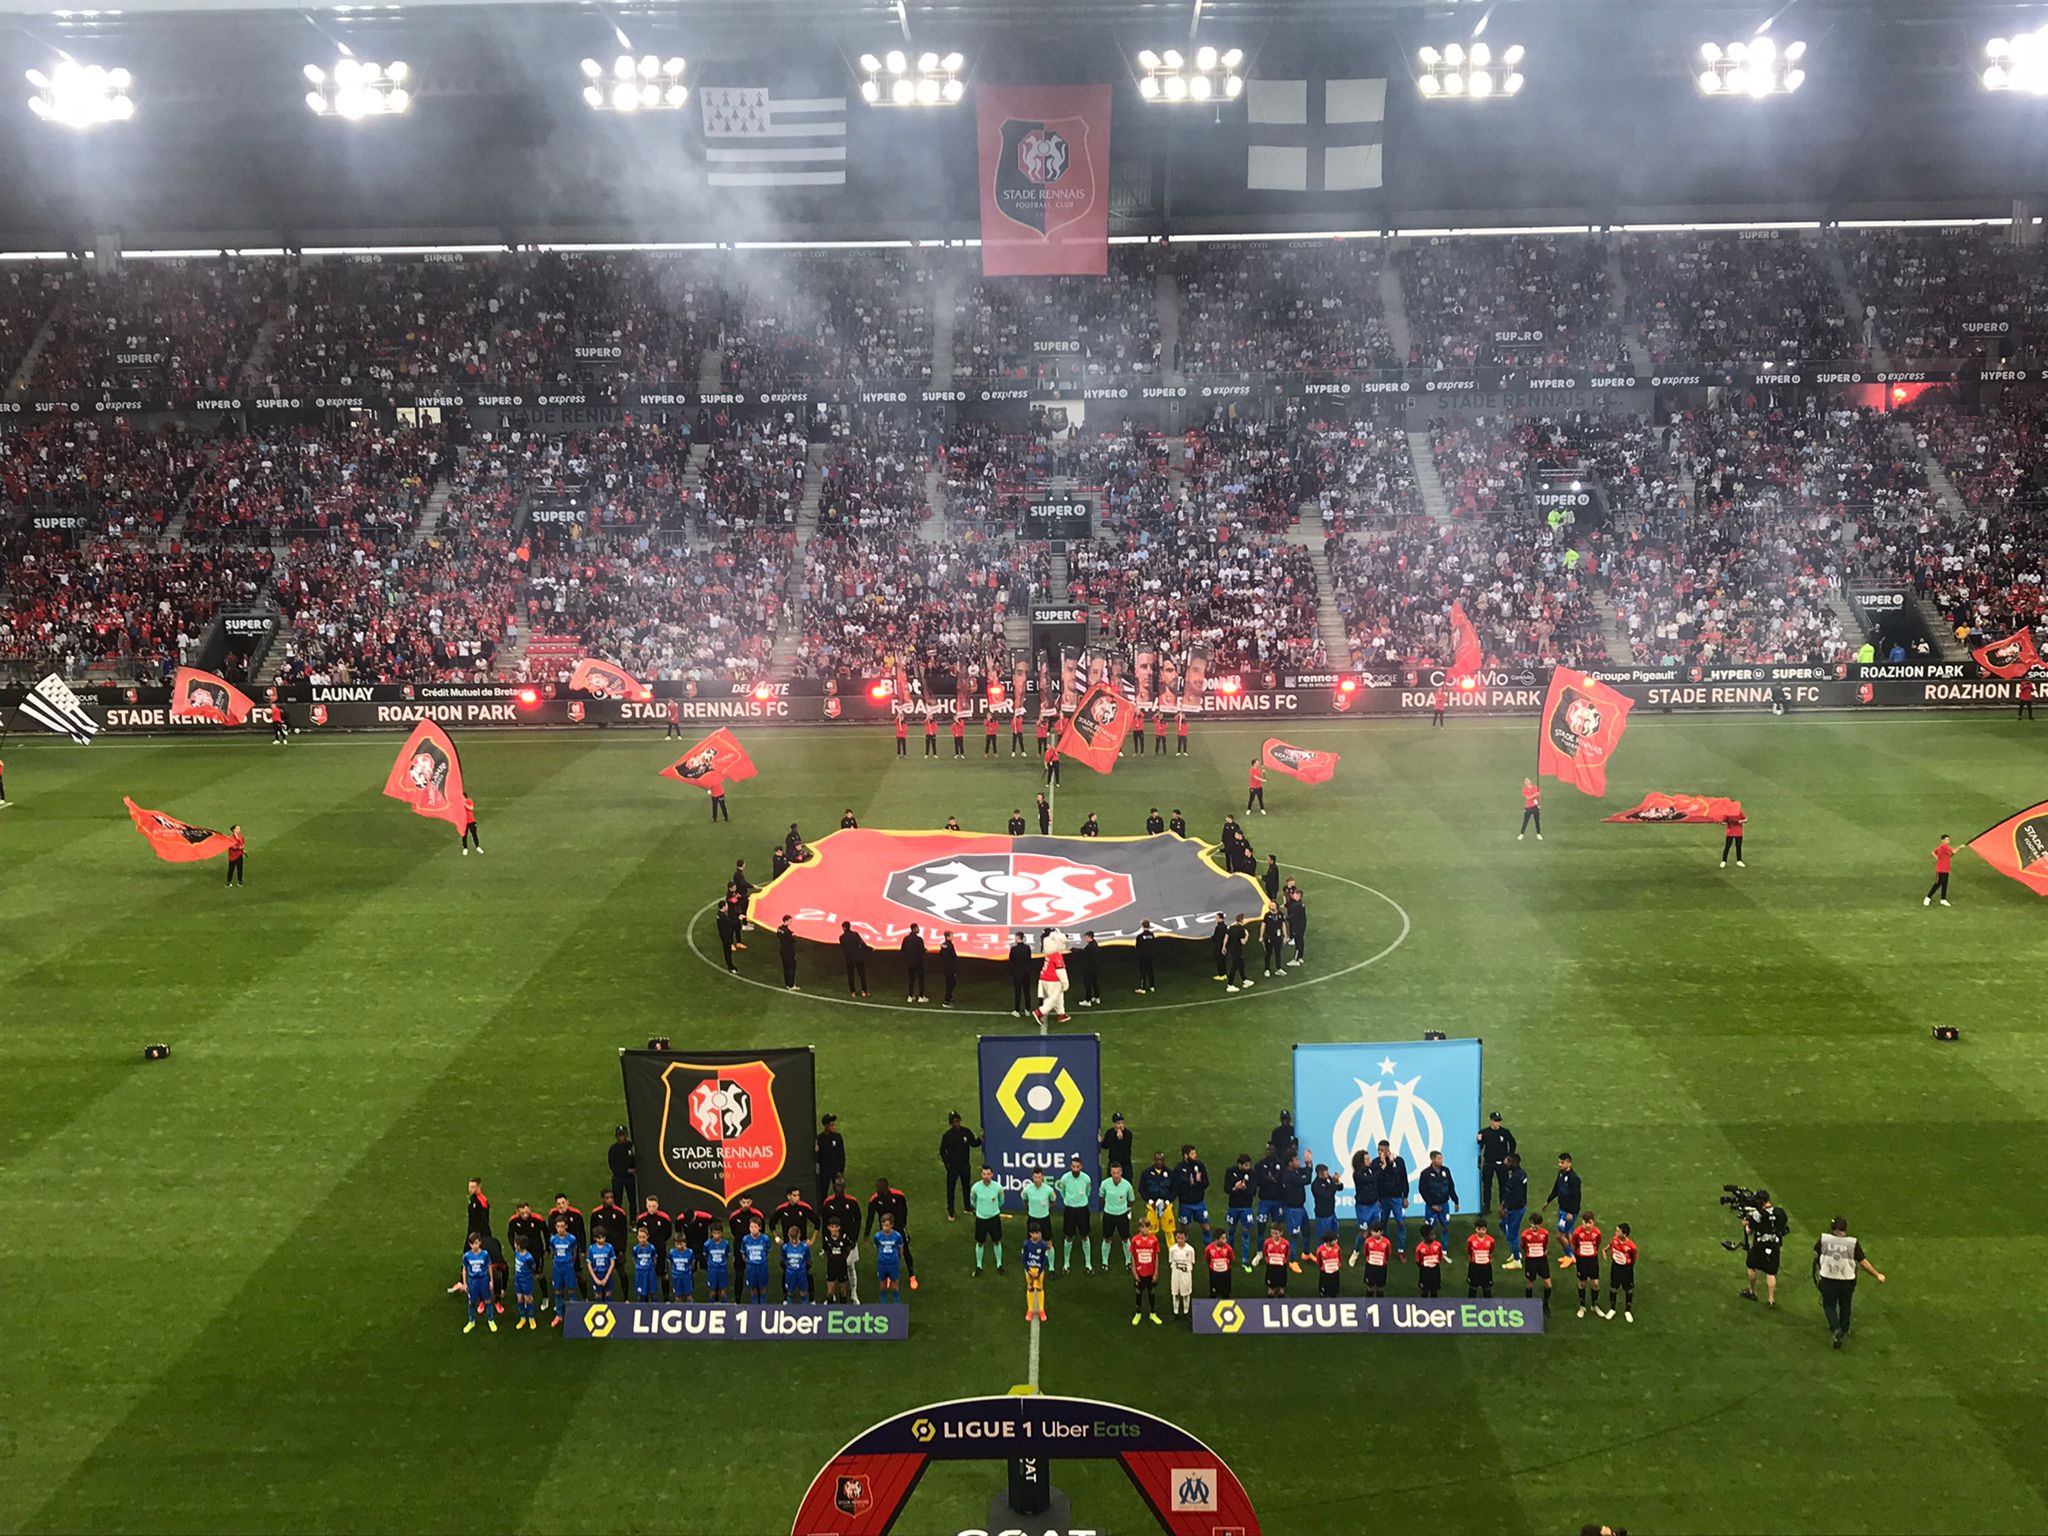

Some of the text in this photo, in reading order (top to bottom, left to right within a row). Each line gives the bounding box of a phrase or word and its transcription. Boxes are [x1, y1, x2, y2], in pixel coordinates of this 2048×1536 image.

[1003, 188, 1085, 200] STADE RENNAIS
[1016, 201, 1051, 209] FOOTBALL
[1738, 231, 1769, 239] SUPER
[423, 254, 454, 263] SUPER
[1962, 322, 1998, 332] SUPER
[1033, 341, 1069, 351] SUPER
[574, 347, 611, 357] SUPER
[116, 354, 153, 363] SUPER
[1663, 376, 1700, 386] express
[1756, 375, 1791, 385] HYPER
[1817, 374, 1851, 383] SUPER
[1888, 372, 1925, 382] express
[1981, 371, 2016, 381] HYPER
[1365, 383, 1399, 393] SUPER
[1437, 381, 1474, 391] express
[1531, 380, 1565, 389] HYPER
[1591, 378, 1625, 388] SUPER
[1084, 390, 1118, 399] HYPER
[1143, 388, 1176, 398] SUPER
[1214, 386, 1250, 397] express
[1306, 385, 1340, 394] HYPER
[549, 395, 586, 405] express
[641, 395, 675, 404] HYPER
[701, 395, 734, 404] SUPER
[771, 393, 808, 403] express
[863, 393, 897, 402] HYPER
[923, 392, 955, 402] SUPER
[992, 390, 1029, 400] express
[105, 400, 142, 412] express
[197, 401, 231, 409] HYPER
[256, 399, 290, 409] SUPER
[326, 397, 363, 408] express
[419, 397, 453, 407] HYPER
[479, 397, 512, 406] SUPER
[562, 408, 643, 423] RENNAS
[1535, 494, 1576, 506] SUPER
[1030, 505, 1072, 516] SUPER
[532, 511, 575, 522] SUPER
[33, 517, 76, 529] SUPER
[1034, 610, 1072, 621] SUPER
[225, 619, 262, 630] SUPER
[1591, 670, 1629, 683] Groupe
[1631, 669, 1674, 682] Pigeault
[1710, 669, 1751, 681] HYPER
[1771, 668, 1812, 679] SUPER
[1860, 665, 1963, 679] ROAZHON PARK
[1297, 674, 1339, 683] rennes
[312, 687, 374, 701] LAUNAY
[422, 687, 448, 697] Crédit
[450, 687, 481, 697] Mutuel
[482, 687, 493, 696] de
[1647, 686, 1818, 704] STADE RENNAS FC
[1923, 683, 2009, 700] ROAZHON
[1275, 695, 1297, 710] FC
[1491, 690, 1540, 706] PARK
[378, 704, 516, 721] ROAZHON PARK
[621, 701, 788, 718] STAD RENNAIS FC
[107, 709, 165, 725] STADE
[2024, 825, 2044, 851] STADE
[672, 1145, 773, 1159] STADE RENNAIS
[688, 1160, 760, 1170] FOOTBALL CLUB
[1002, 1152, 1065, 1168] LIGUE
[997, 1174, 1030, 1191] Ube
[1262, 1303, 1525, 1328] LIGUE 1 Uber Eats
[633, 1309, 889, 1335] LIGUE 1 Uber Eats
[943, 1419, 1141, 1439] LIGUE 1 Uber Eats
